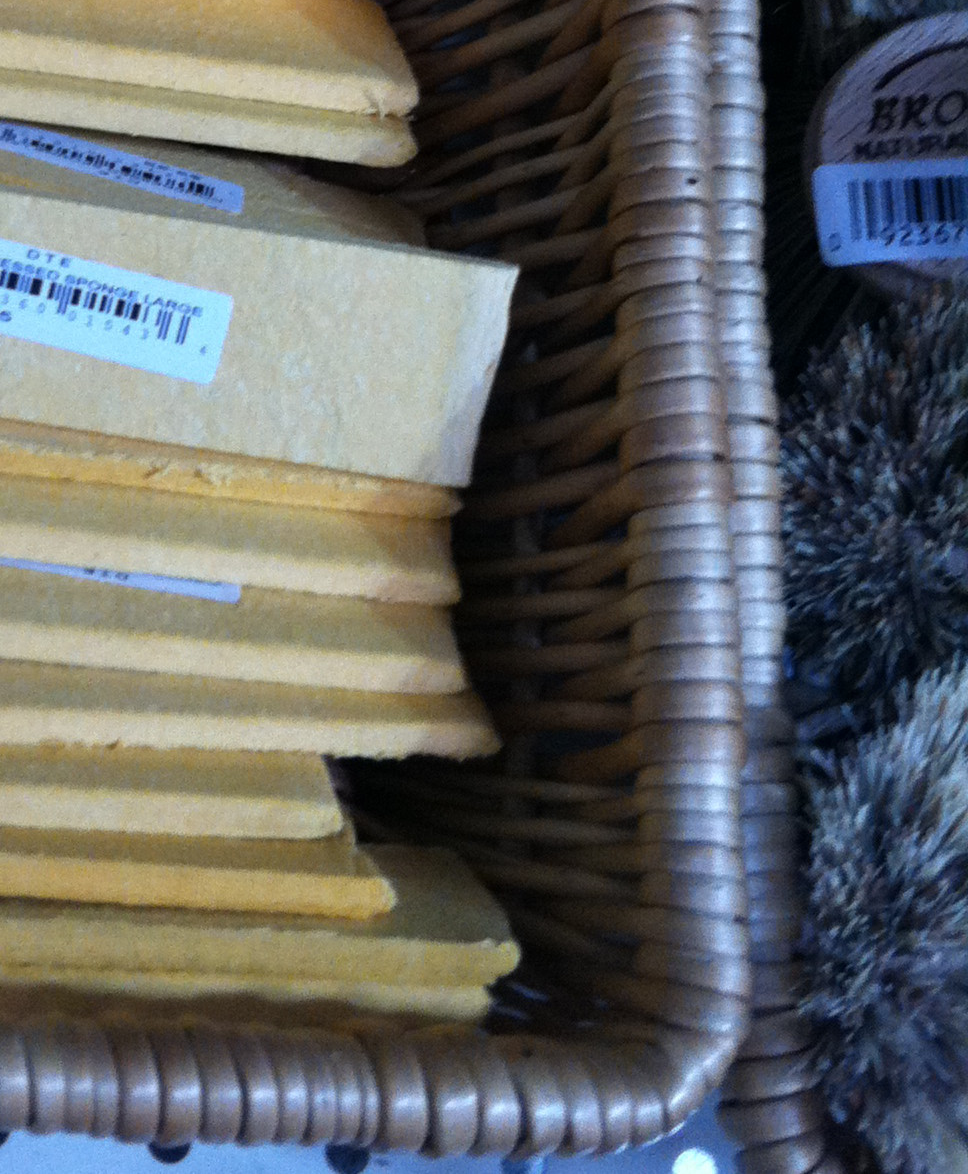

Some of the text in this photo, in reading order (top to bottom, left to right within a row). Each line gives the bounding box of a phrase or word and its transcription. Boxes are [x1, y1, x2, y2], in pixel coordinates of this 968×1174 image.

[26, 248, 72, 269] DTE
[64, 272, 140, 300] SPONGE
[143, 293, 204, 318] LARGE
